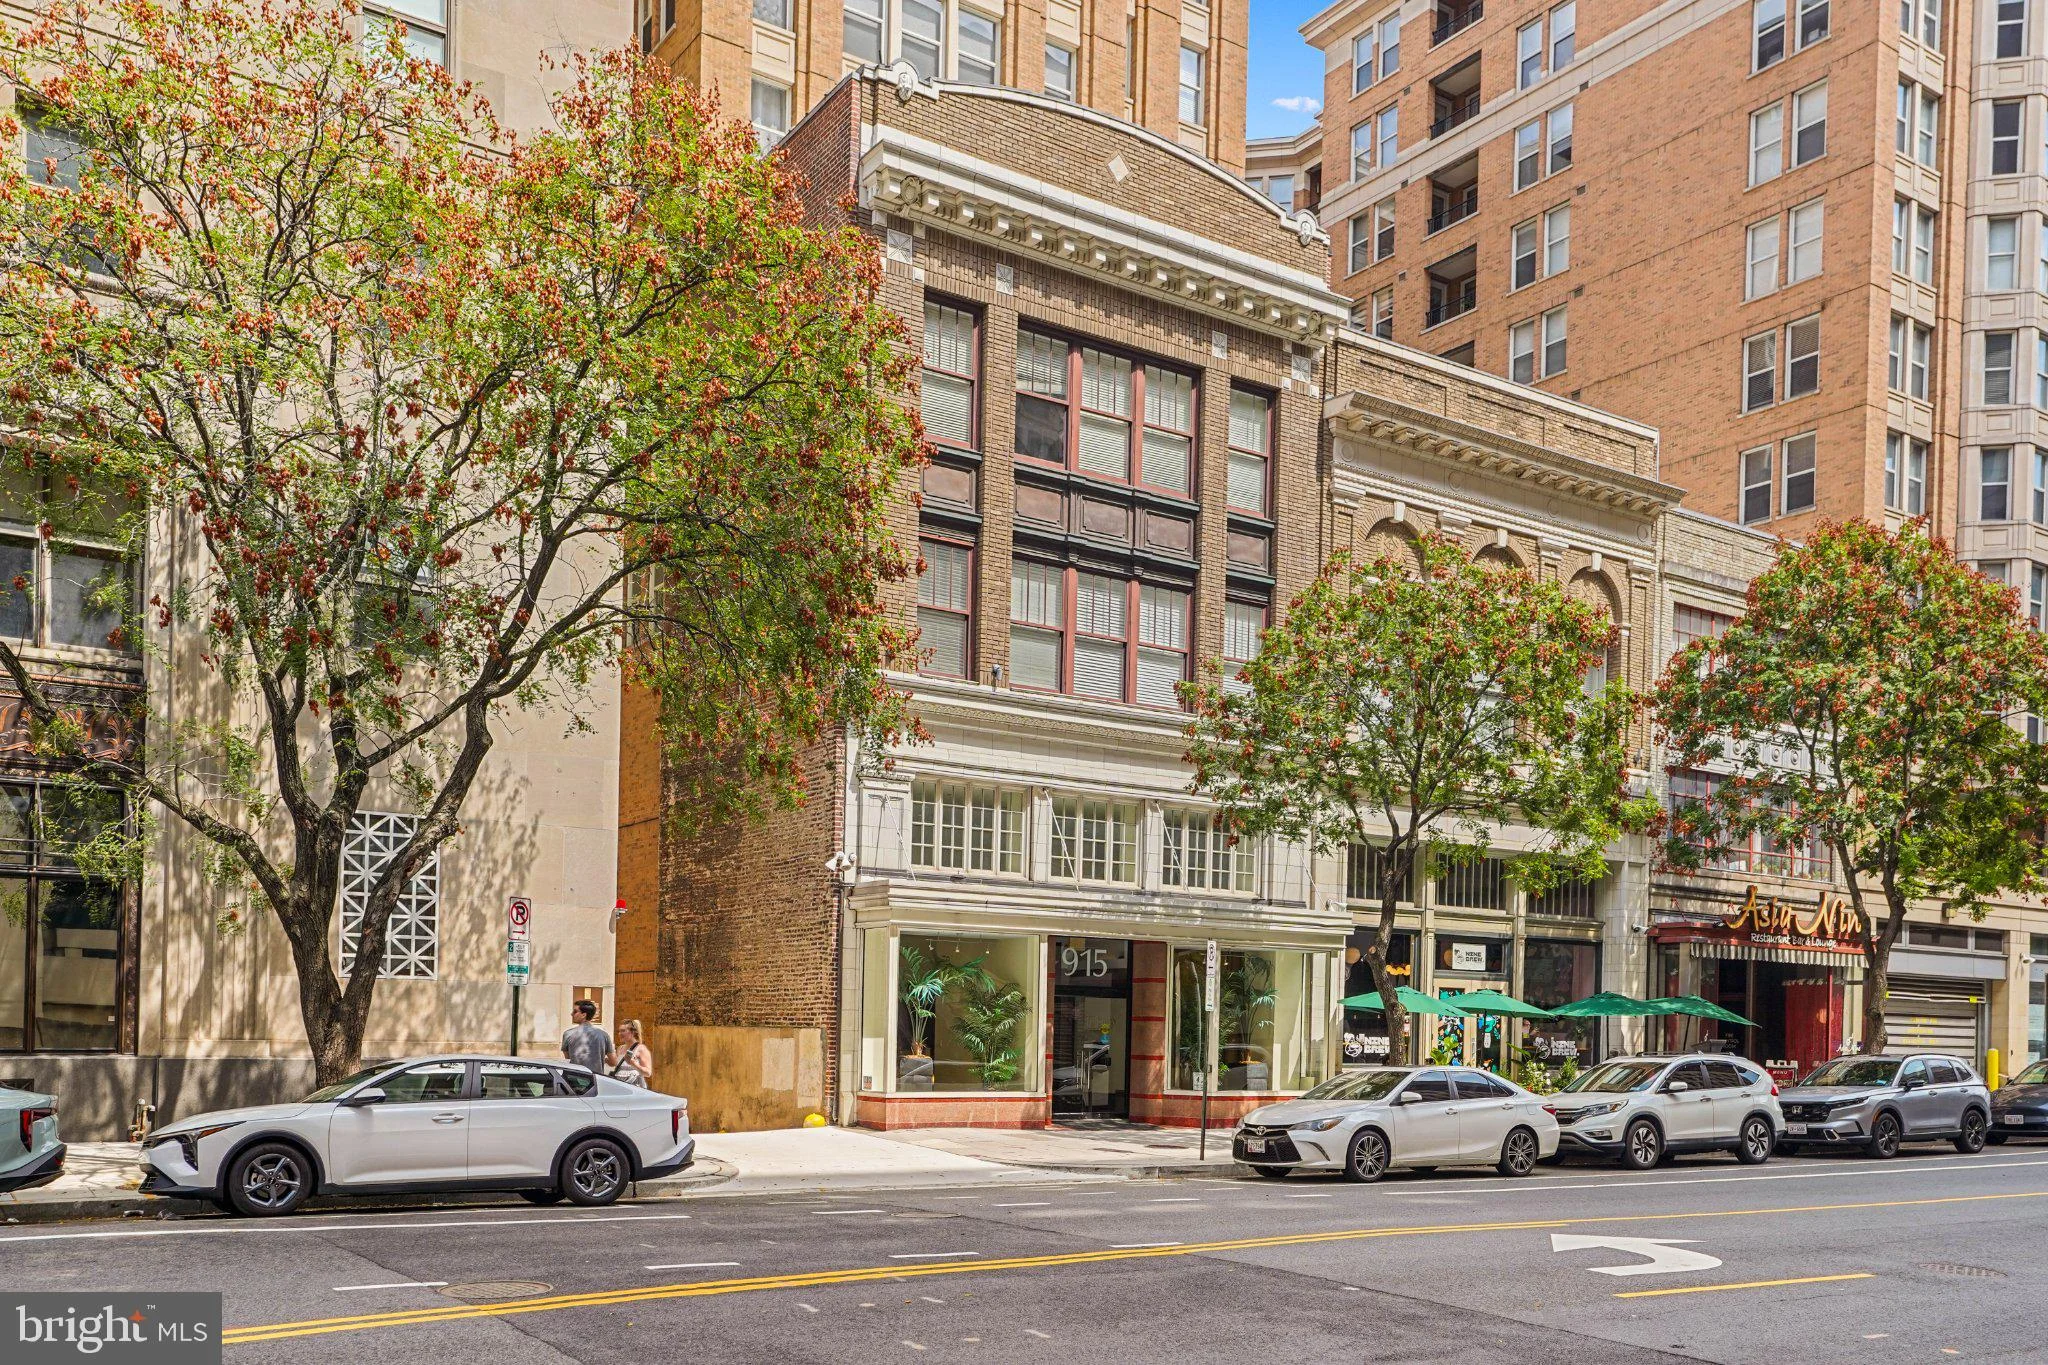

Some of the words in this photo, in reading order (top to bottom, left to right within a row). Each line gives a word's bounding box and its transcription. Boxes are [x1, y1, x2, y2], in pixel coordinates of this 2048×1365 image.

[1725, 885, 1793, 931] Asia
[1794, 891, 1871, 935] Nin
[1751, 933, 1791, 945] Restaurant
[1792, 935, 1805, 946] Bar
[1805, 936, 1811, 946] &
[1811, 936, 1837, 950] Lounge
[1061, 947, 1108, 978] 915
[1551, 1040, 1576, 1049] NINE
